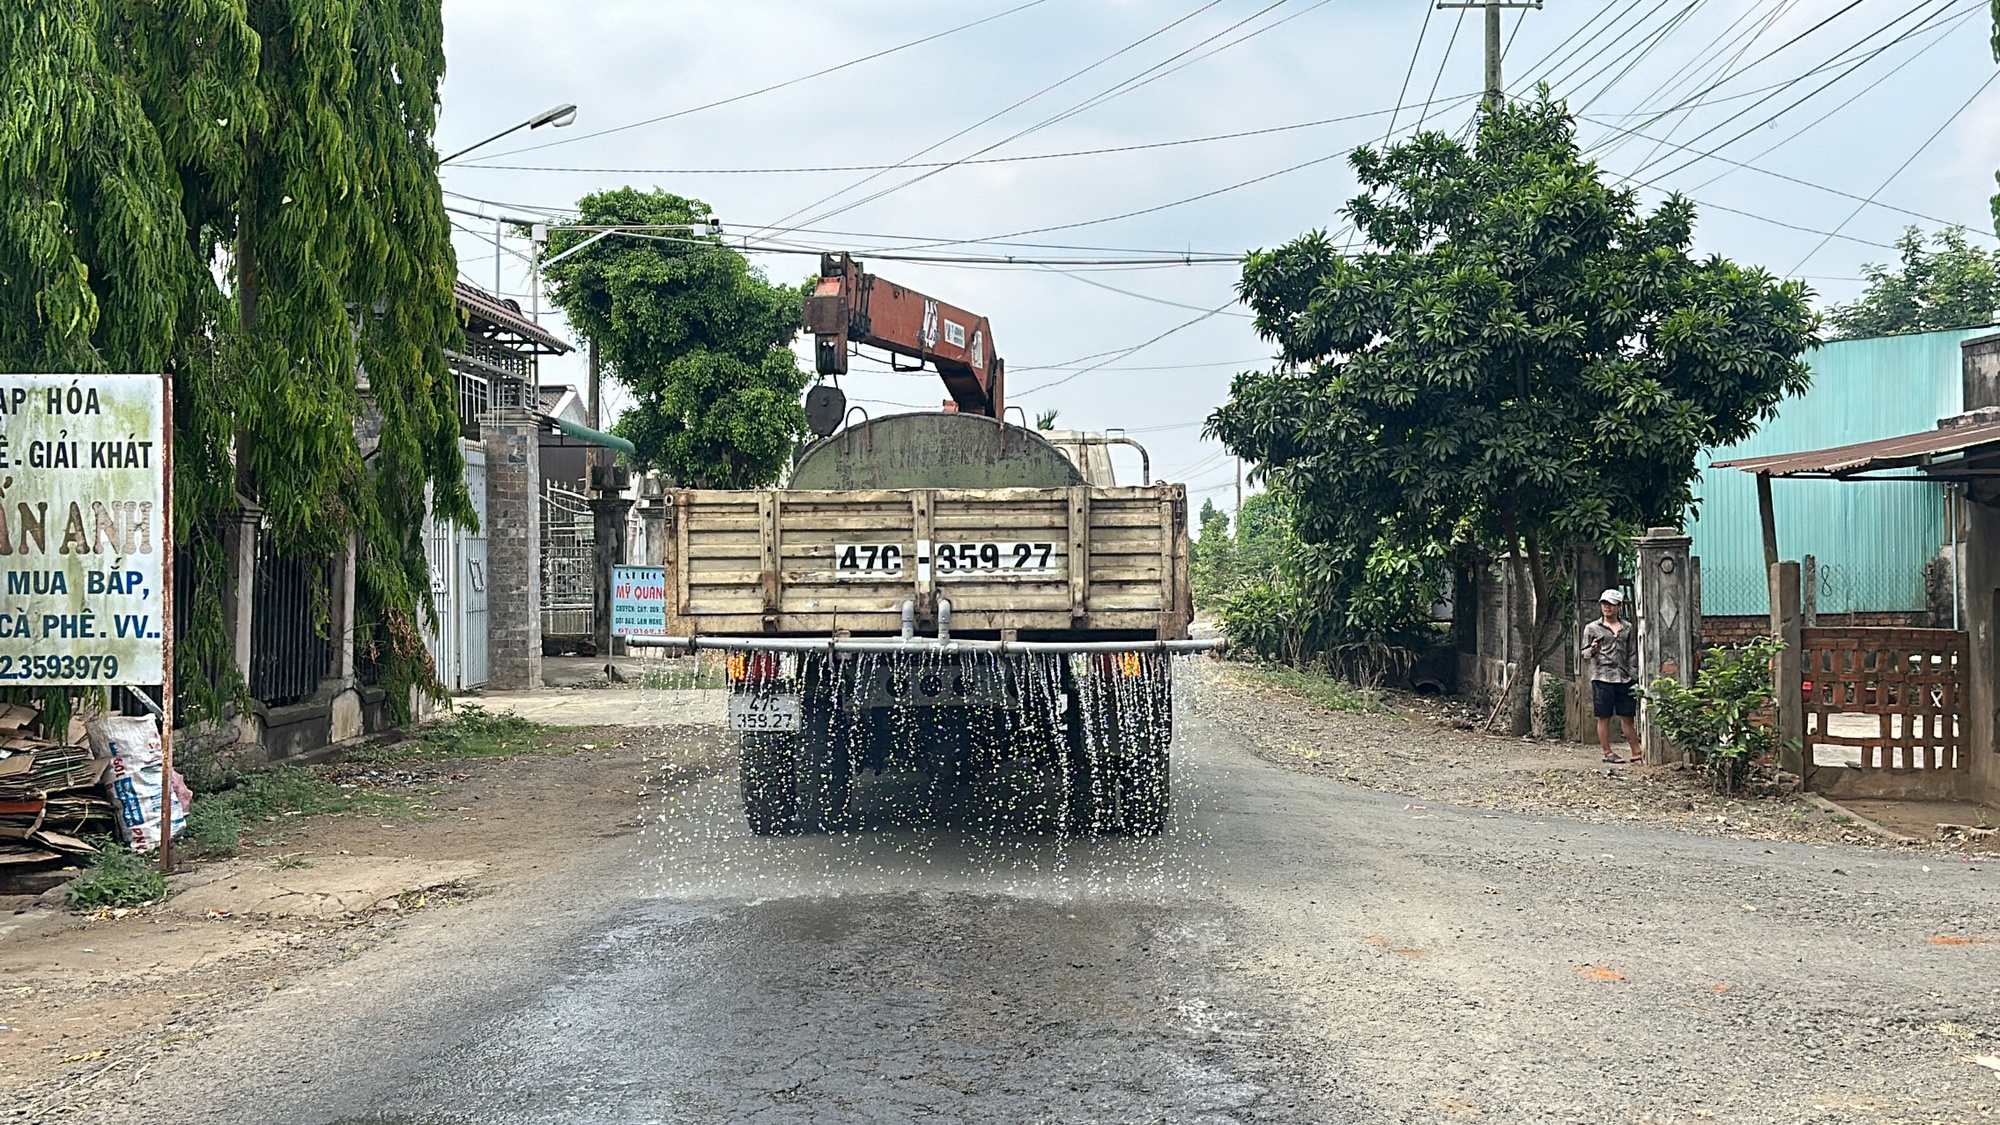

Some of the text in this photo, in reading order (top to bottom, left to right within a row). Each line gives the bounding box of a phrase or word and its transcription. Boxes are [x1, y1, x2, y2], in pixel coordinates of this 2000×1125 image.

[47, 379, 100, 415] HÓA
[29, 430, 77, 468] GIẢI
[91, 432, 152, 468] KHÁT
[59, 501, 153, 555] ANH
[839, 545, 901, 575] 47C
[937, 543, 1052, 574] 359.27
[8, 557, 149, 600] MUA BẮP,
[749, 697, 781, 712] 47C
